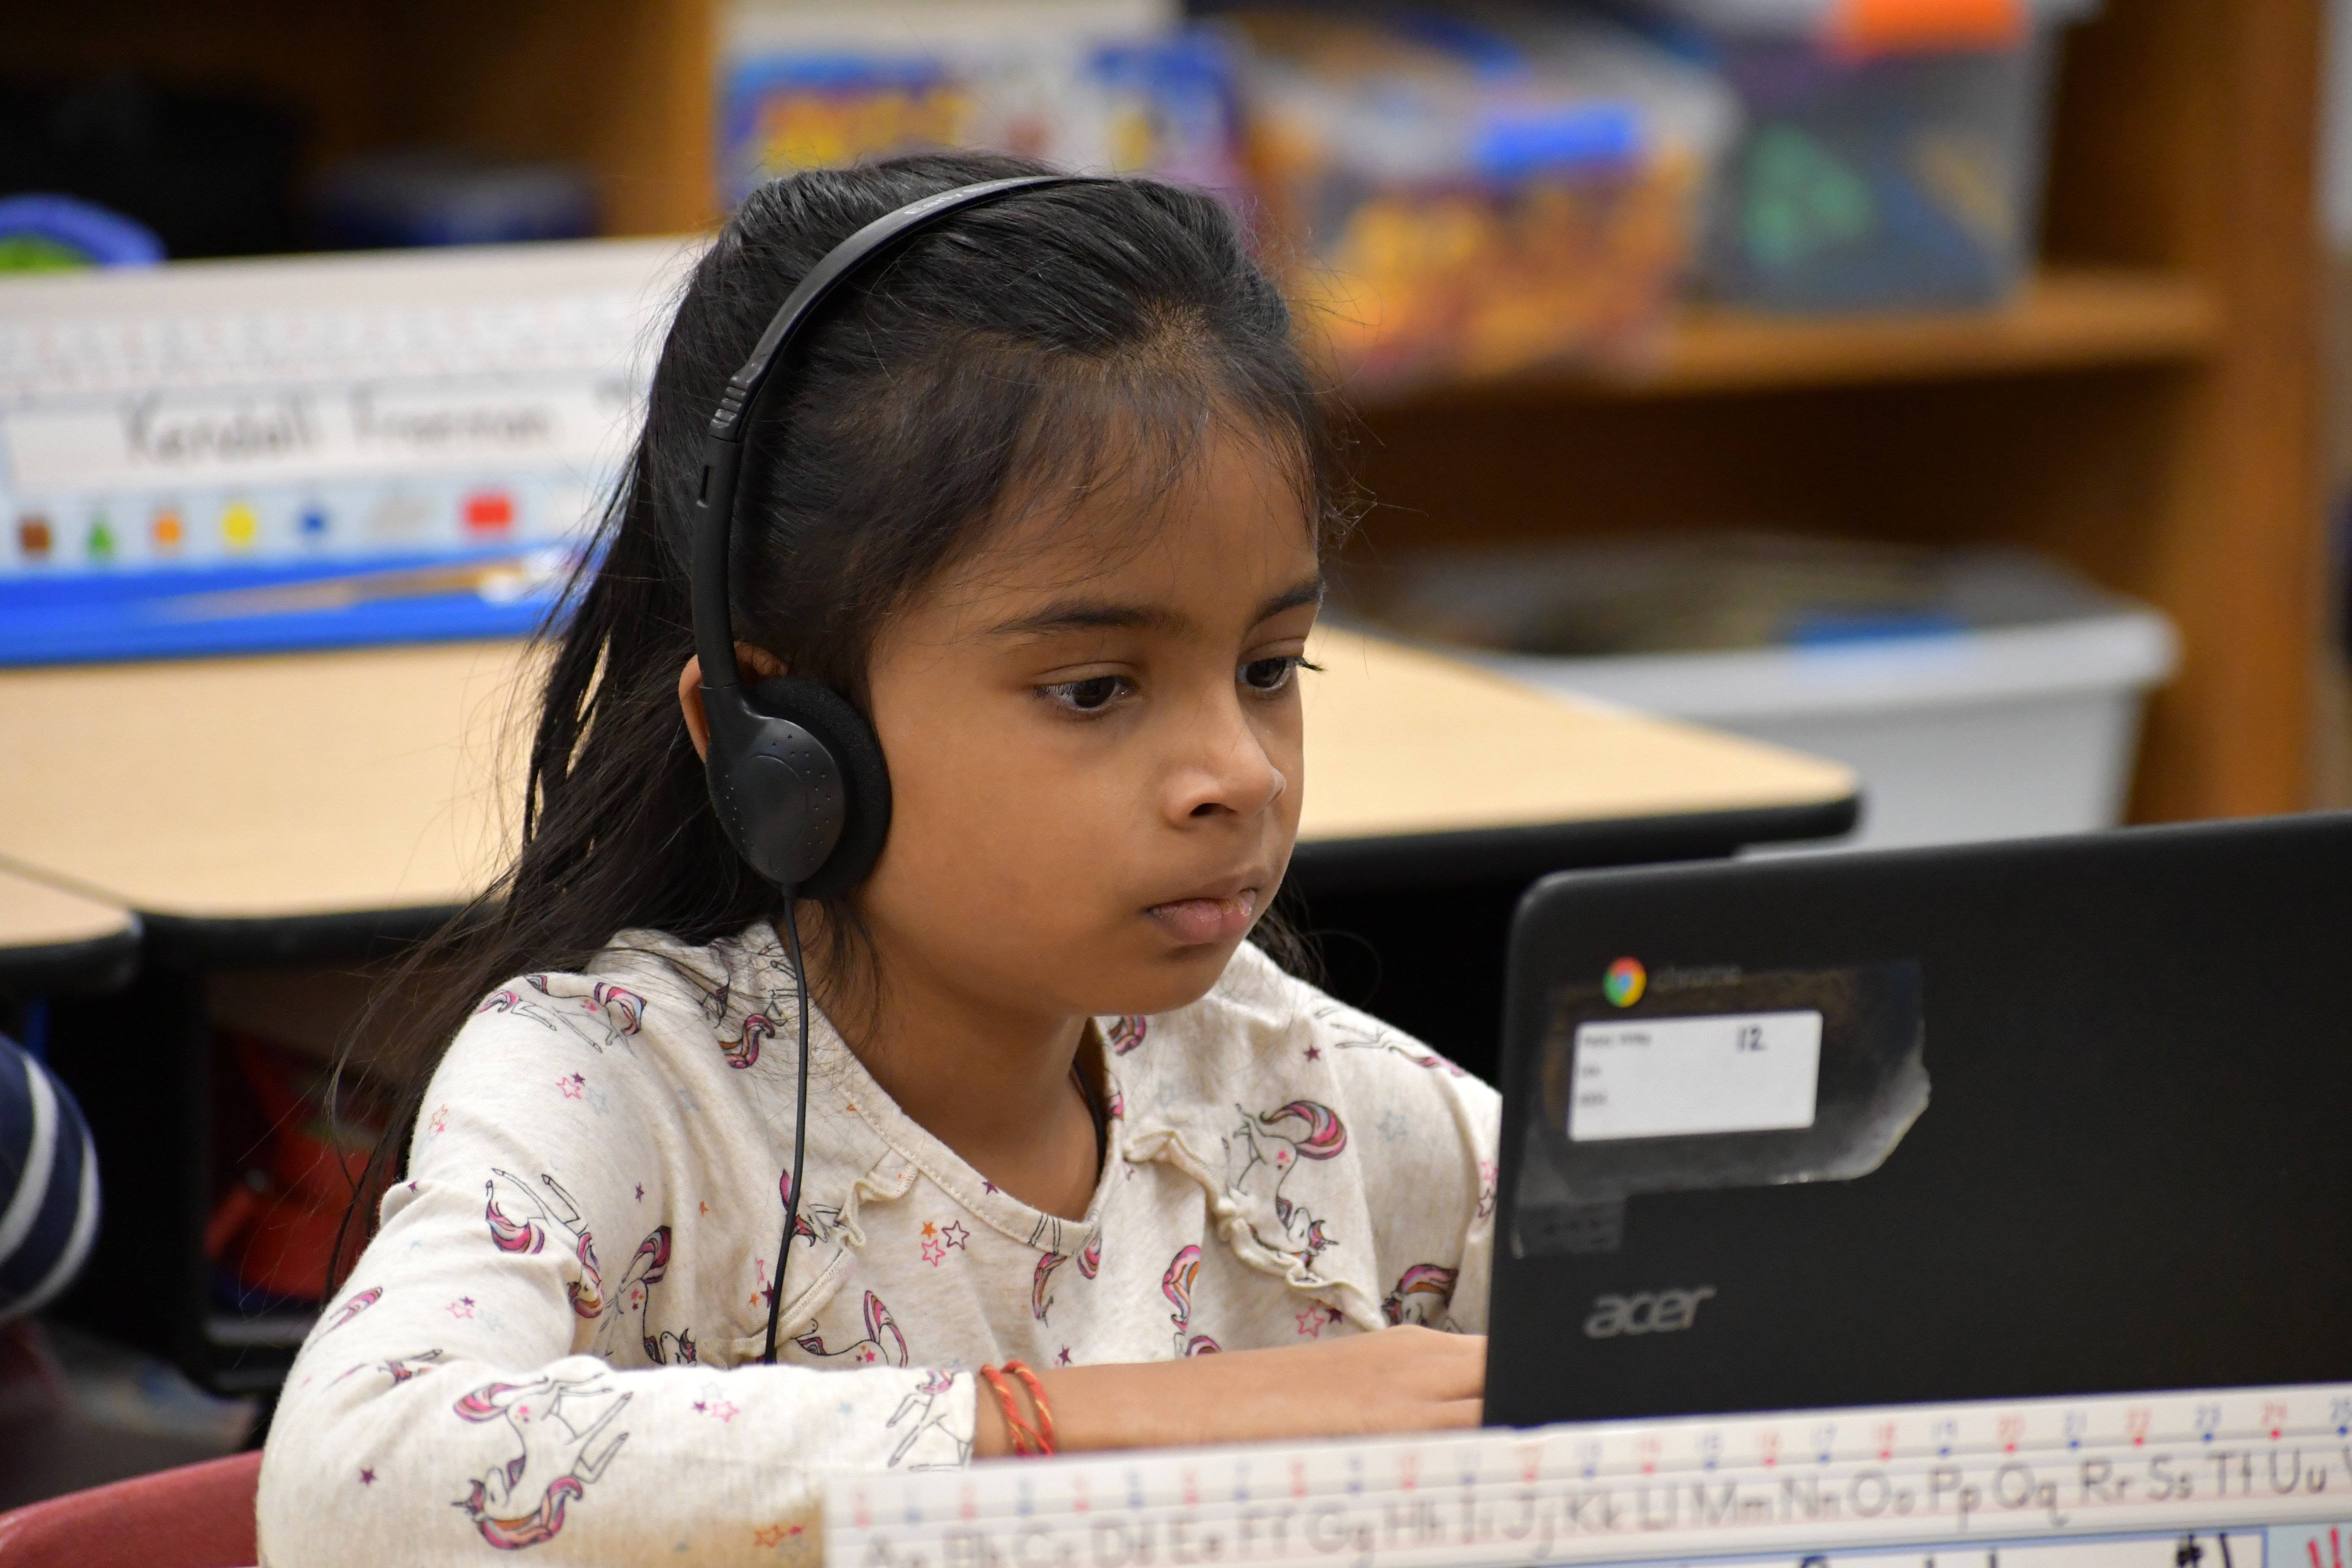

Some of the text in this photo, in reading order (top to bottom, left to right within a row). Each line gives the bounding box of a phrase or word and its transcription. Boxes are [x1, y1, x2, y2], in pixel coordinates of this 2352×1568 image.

[1735, 1024, 1767, 1053] 12
[1583, 1285, 1717, 1339] acer
[1929, 1465, 1981, 1533] Pp
[2079, 1457, 2132, 1503] Rr
[2147, 1454, 2194, 1501] Ss
[2269, 1447, 2328, 1494] Uu
